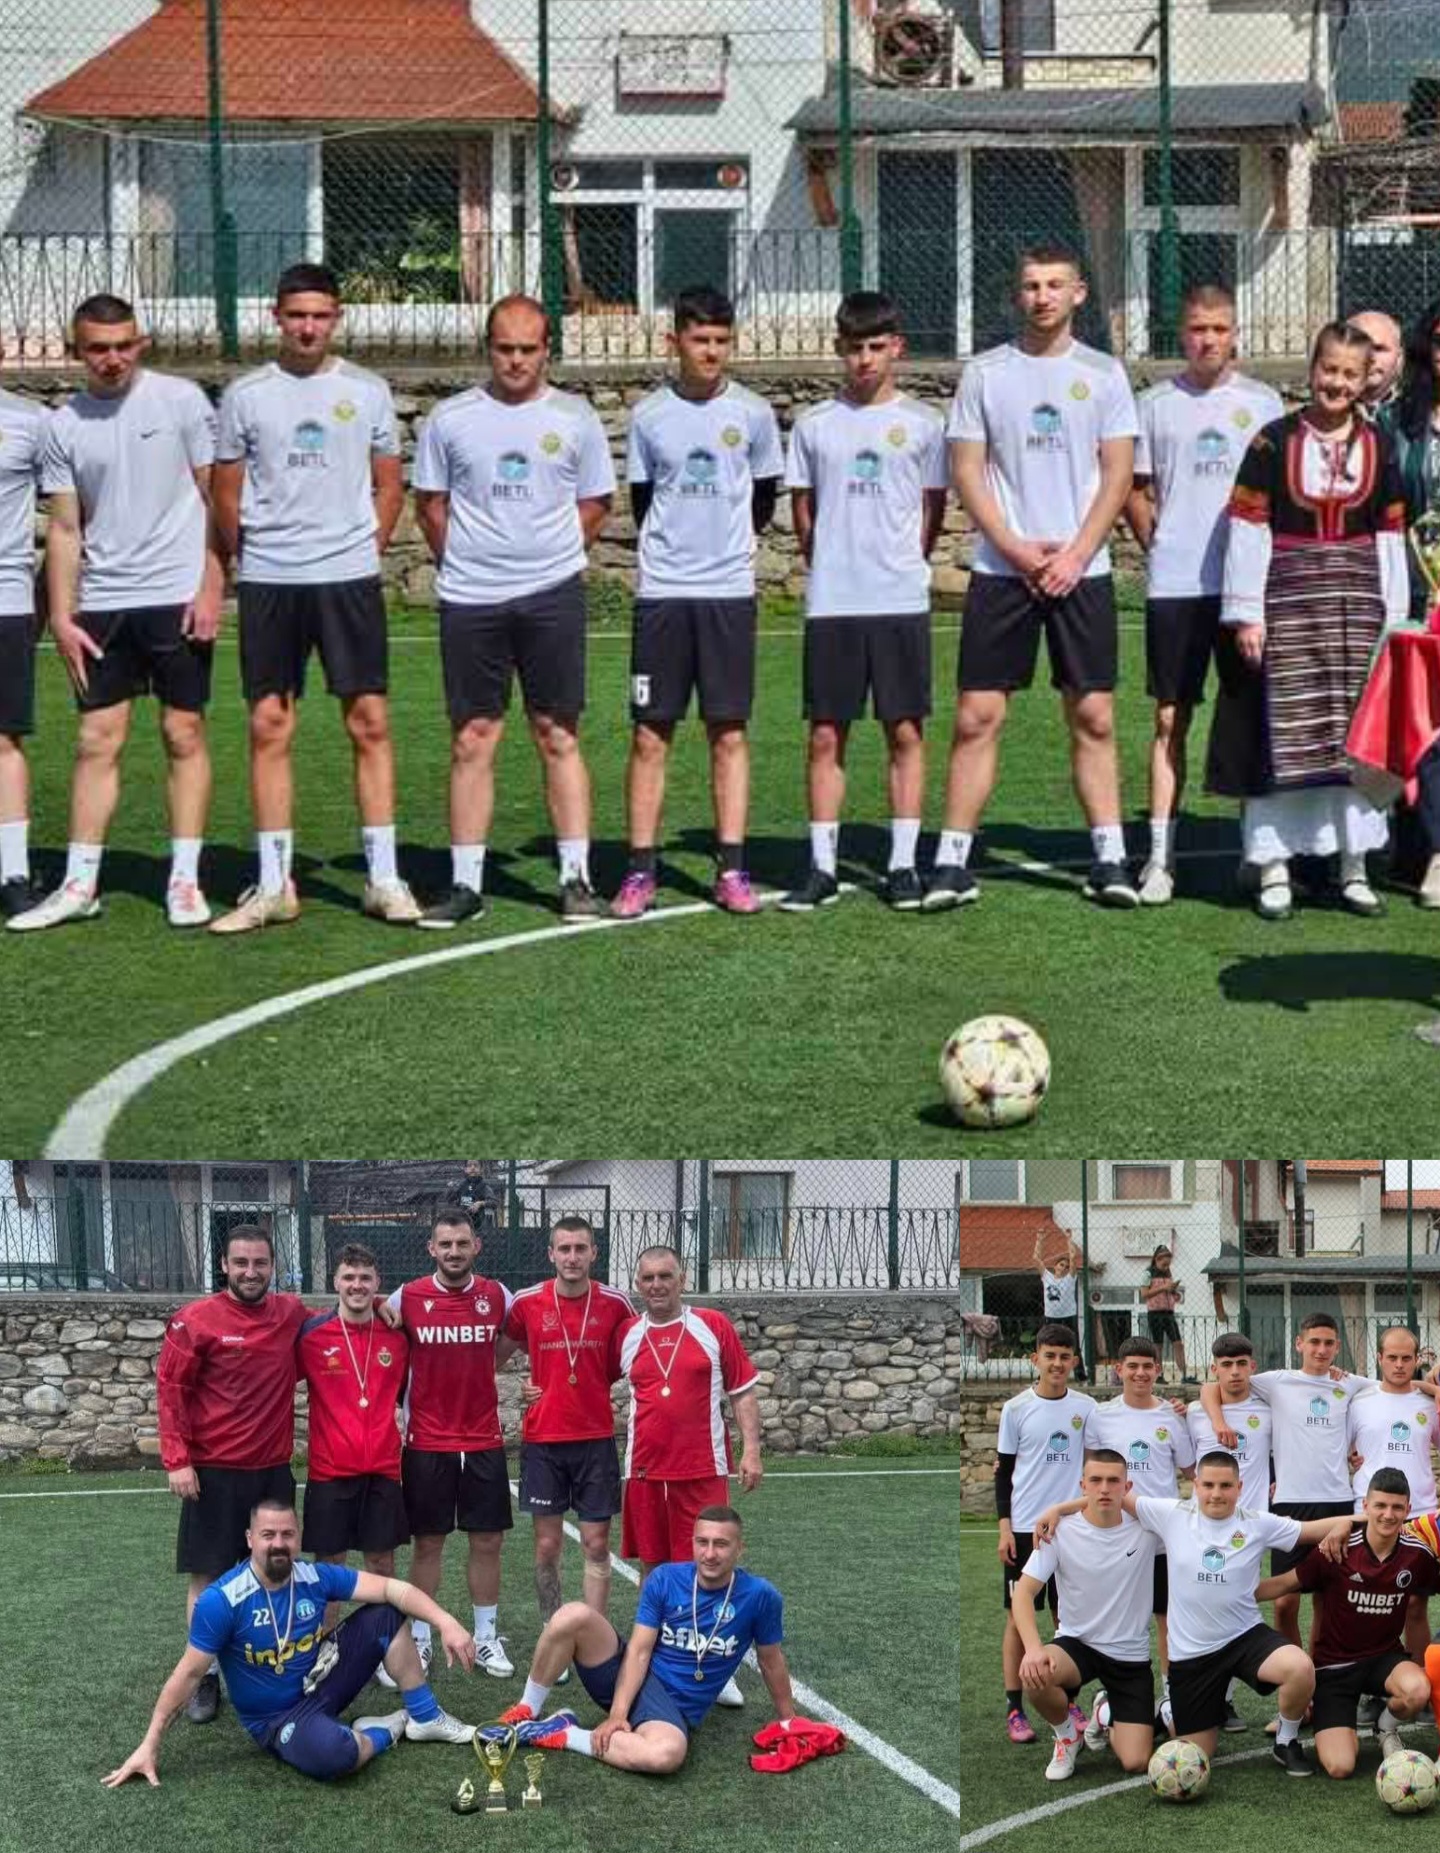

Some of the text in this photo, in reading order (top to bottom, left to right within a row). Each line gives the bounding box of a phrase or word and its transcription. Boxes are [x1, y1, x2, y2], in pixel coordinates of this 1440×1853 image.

[417, 1325, 496, 1343] WINBET
[1306, 1417, 1331, 1426] BETL
[1388, 1442, 1412, 1451] BETL
[1046, 1453, 1070, 1462] BETL
[1231, 1452, 1249, 1460] ETL
[1127, 1462, 1152, 1470] BETL
[1197, 1572, 1227, 1583] BETL
[1347, 1590, 1404, 1606] UNIBET
[252, 1608, 270, 1627] 22
